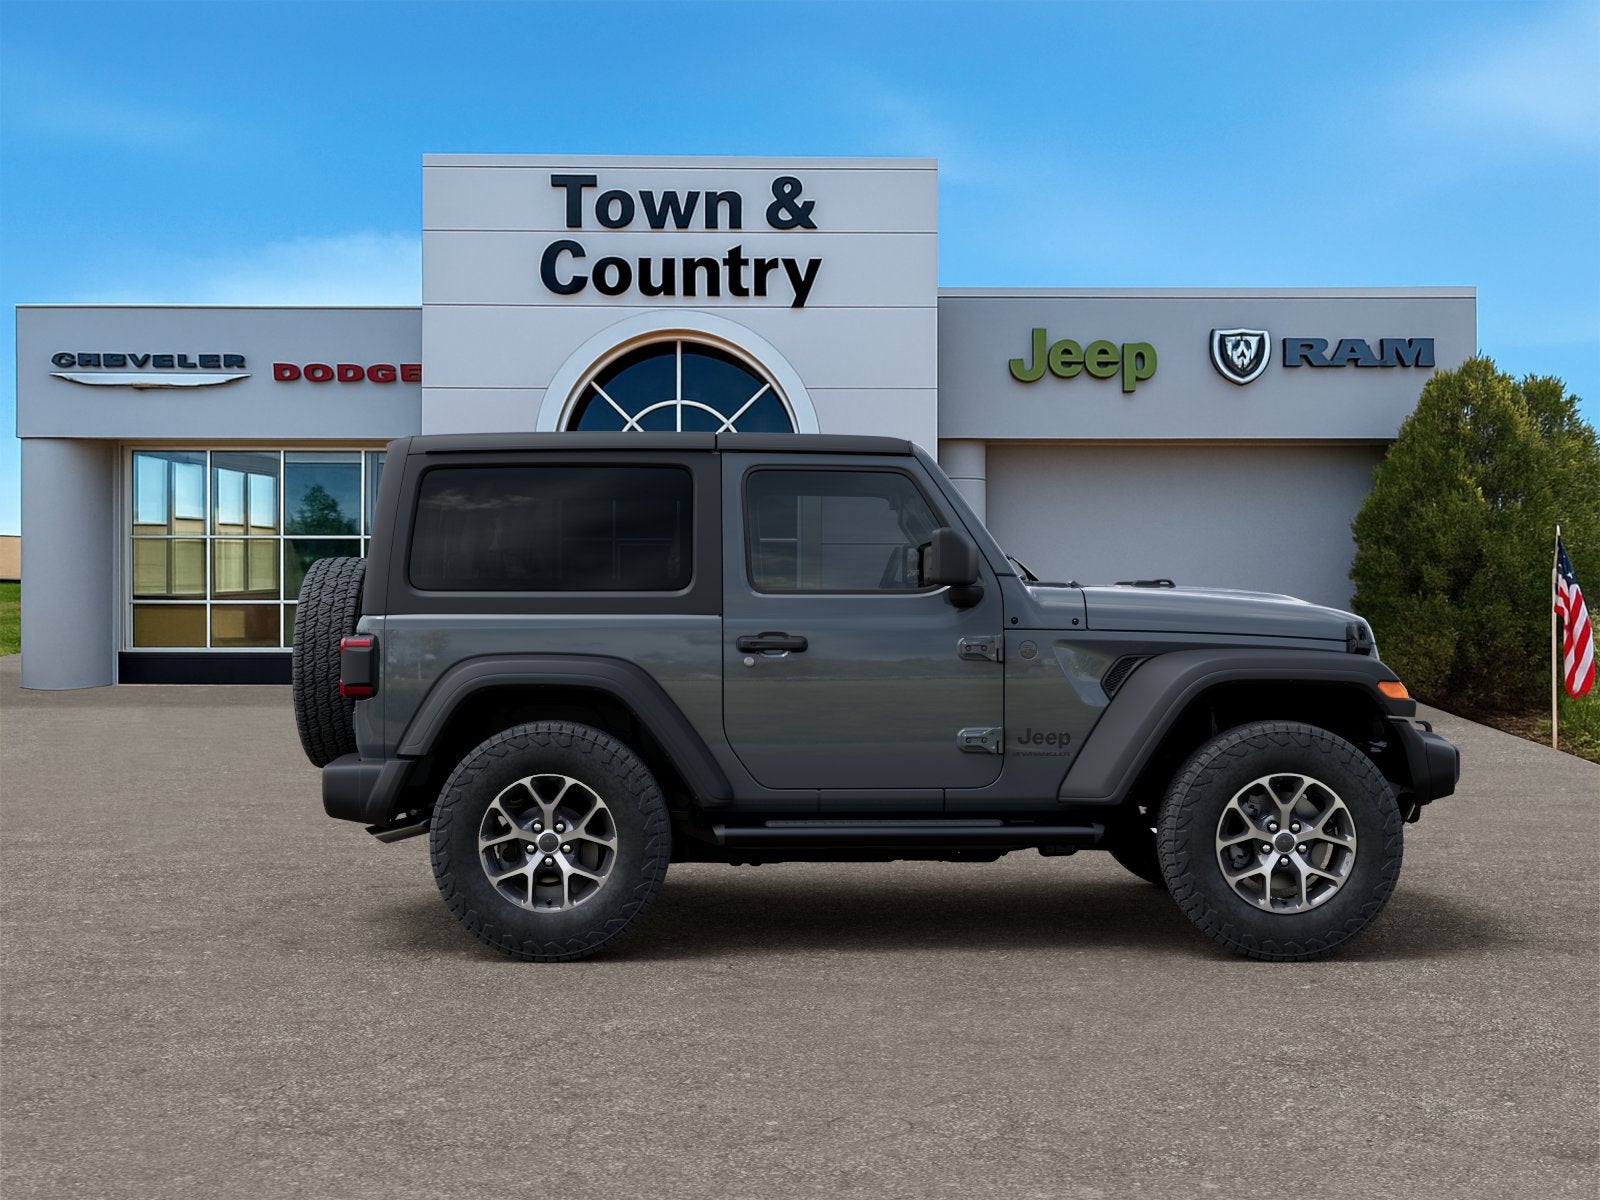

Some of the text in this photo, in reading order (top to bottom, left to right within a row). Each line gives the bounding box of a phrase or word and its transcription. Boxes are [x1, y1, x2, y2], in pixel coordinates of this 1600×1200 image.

[551, 174, 818, 230] Town &
[540, 239, 822, 308] Country
[273, 363, 421, 383] DODGE
[1008, 328, 1157, 392] Jeep
[1283, 337, 1434, 367] RAM
[1018, 728, 1071, 749] Jeep
